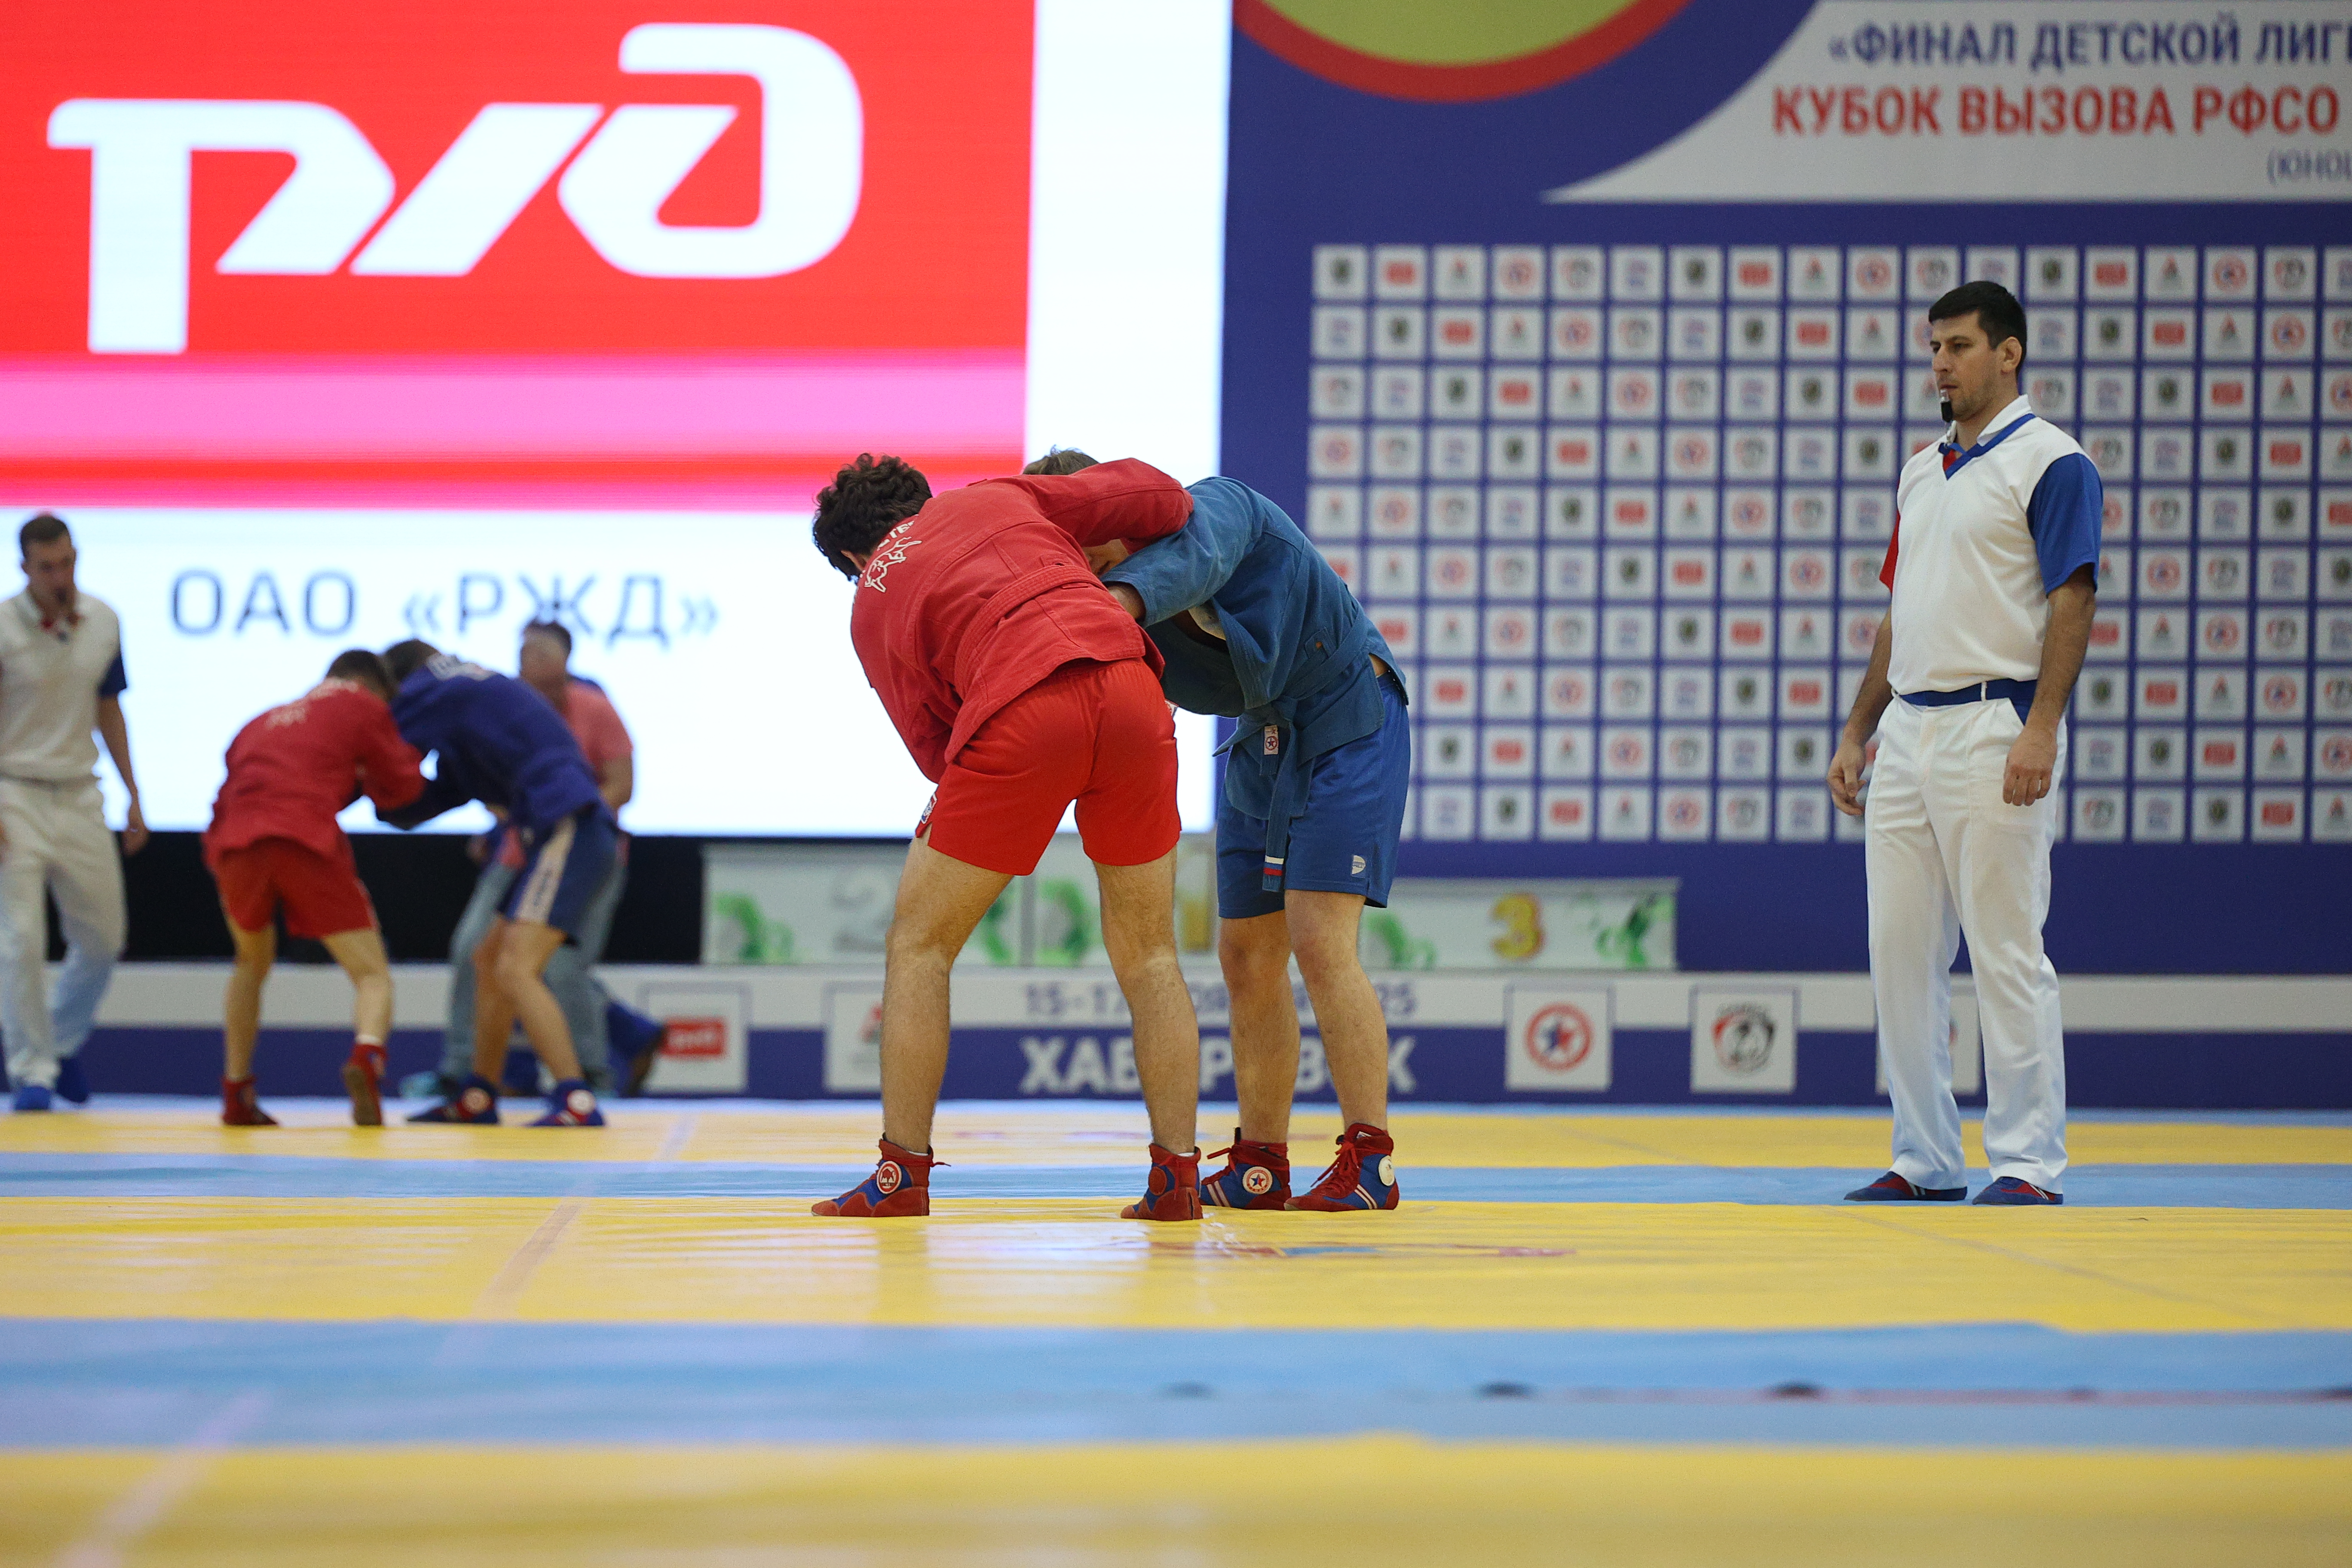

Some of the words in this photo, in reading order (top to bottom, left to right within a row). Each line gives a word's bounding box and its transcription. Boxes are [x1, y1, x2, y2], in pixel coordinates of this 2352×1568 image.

[1828, 21, 2017, 67] «ФИНАЛ
[2030, 11, 2240, 72] ДЕТСКОЙ
[1772, 85, 1943, 136] КУБОК
[1957, 85, 2175, 136] ВЫЗОВА
[2191, 83, 2340, 138] РФСО
[170, 569, 355, 636] ОАО
[402, 573, 720, 649] «РЖД»
[1487, 892, 1547, 961] 3
